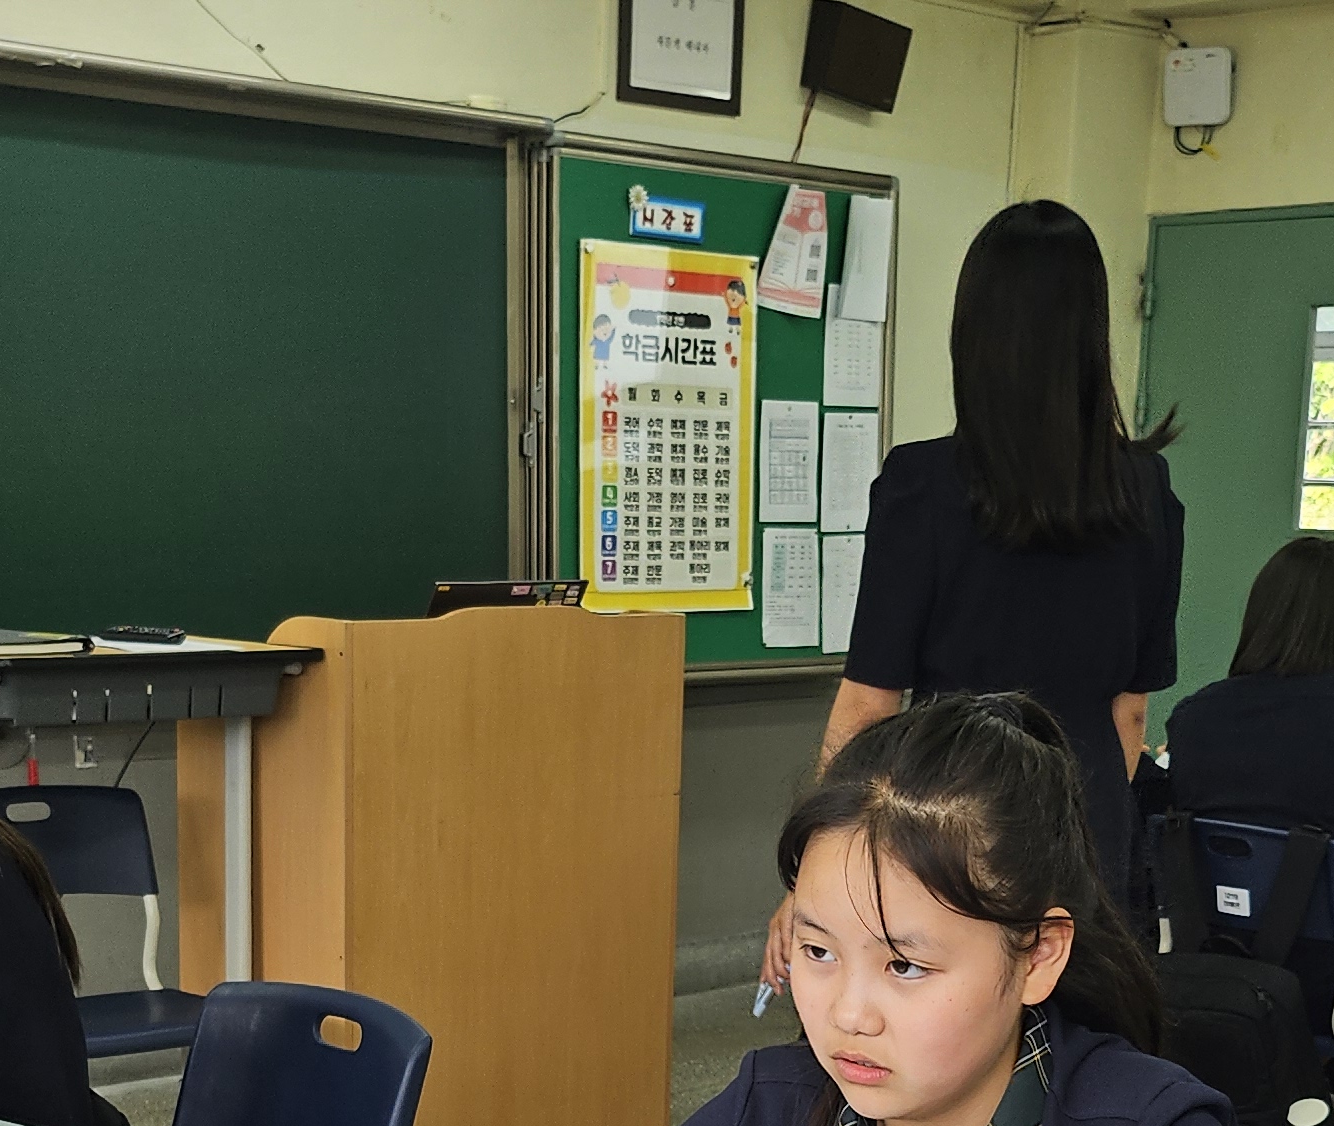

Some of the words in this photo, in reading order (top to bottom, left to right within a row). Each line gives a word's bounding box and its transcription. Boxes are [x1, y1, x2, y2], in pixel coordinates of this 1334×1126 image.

[621, 333, 717, 366] 학급시간표
[651, 389, 660, 402] 화
[674, 390, 683, 404] 수
[697, 391, 706, 405] 목
[719, 392, 727, 406] 금
[607, 512, 614, 524] 5
[606, 537, 613, 550] 6
[605, 562, 613, 574] 7
